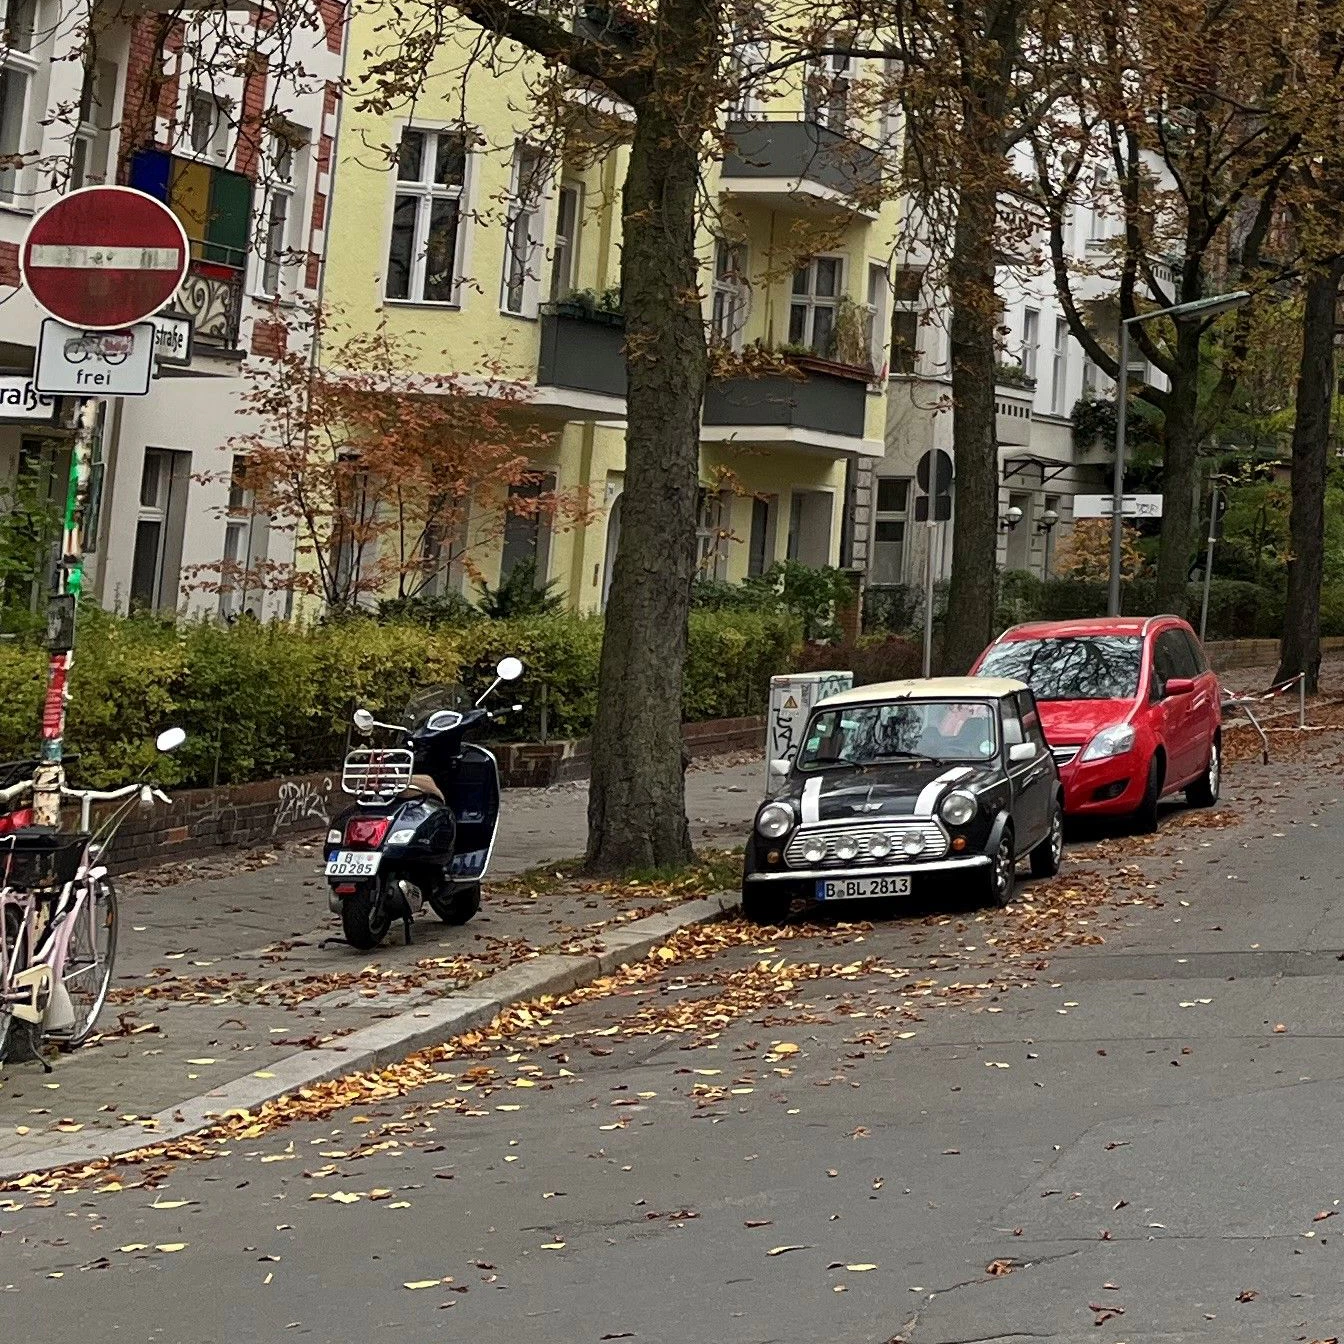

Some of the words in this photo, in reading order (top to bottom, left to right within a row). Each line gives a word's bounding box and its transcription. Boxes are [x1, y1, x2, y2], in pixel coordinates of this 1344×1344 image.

[155, 325, 183, 353] straße
[76, 369, 111, 386] frei
[344, 853, 353, 864] B
[349, 864, 373, 874] 285
[826, 883, 836, 898] B
[846, 881, 867, 896] BL
[869, 879, 909, 895] 2813
